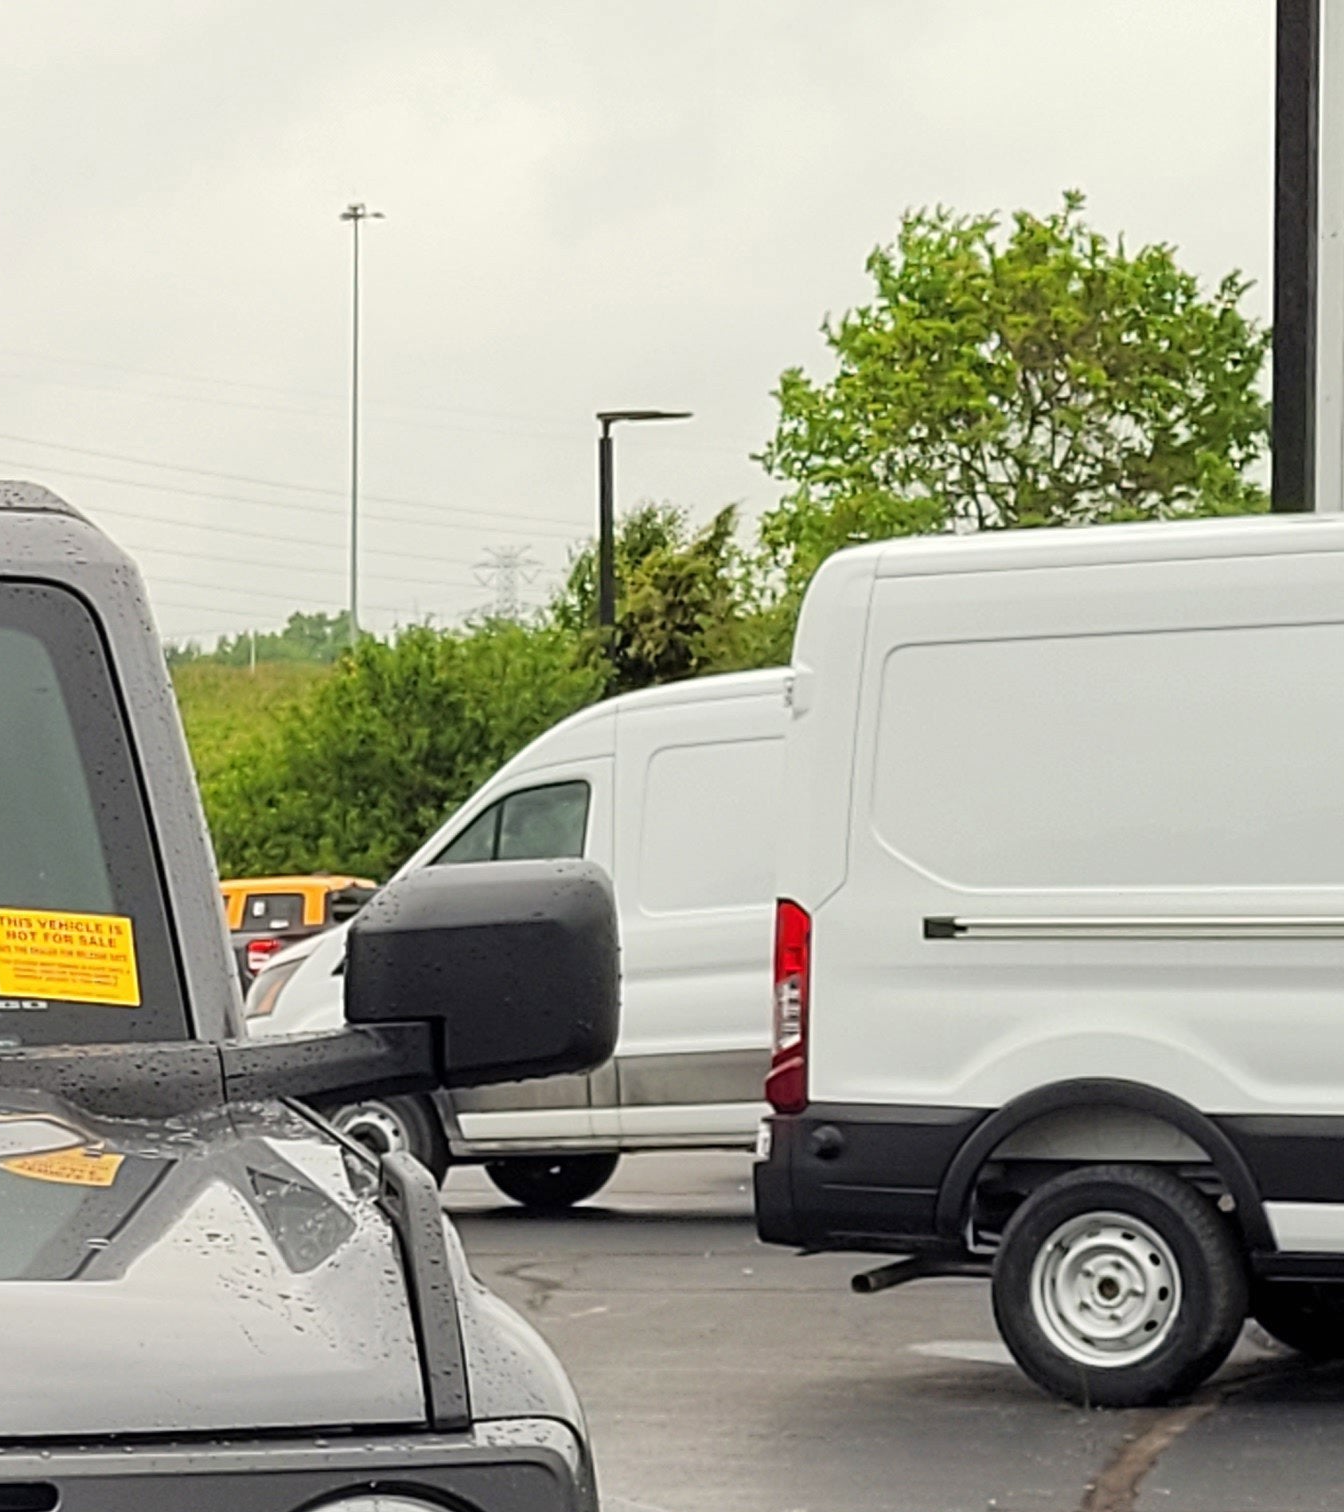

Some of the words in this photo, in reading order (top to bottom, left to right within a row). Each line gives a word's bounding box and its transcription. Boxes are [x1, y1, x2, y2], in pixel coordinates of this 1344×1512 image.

[38, 918, 103, 934] VEHICLE
[109, 923, 123, 936] IS
[5, 930, 37, 942] NOT
[43, 932, 74, 945] FOR
[78, 934, 117, 948] SALE
